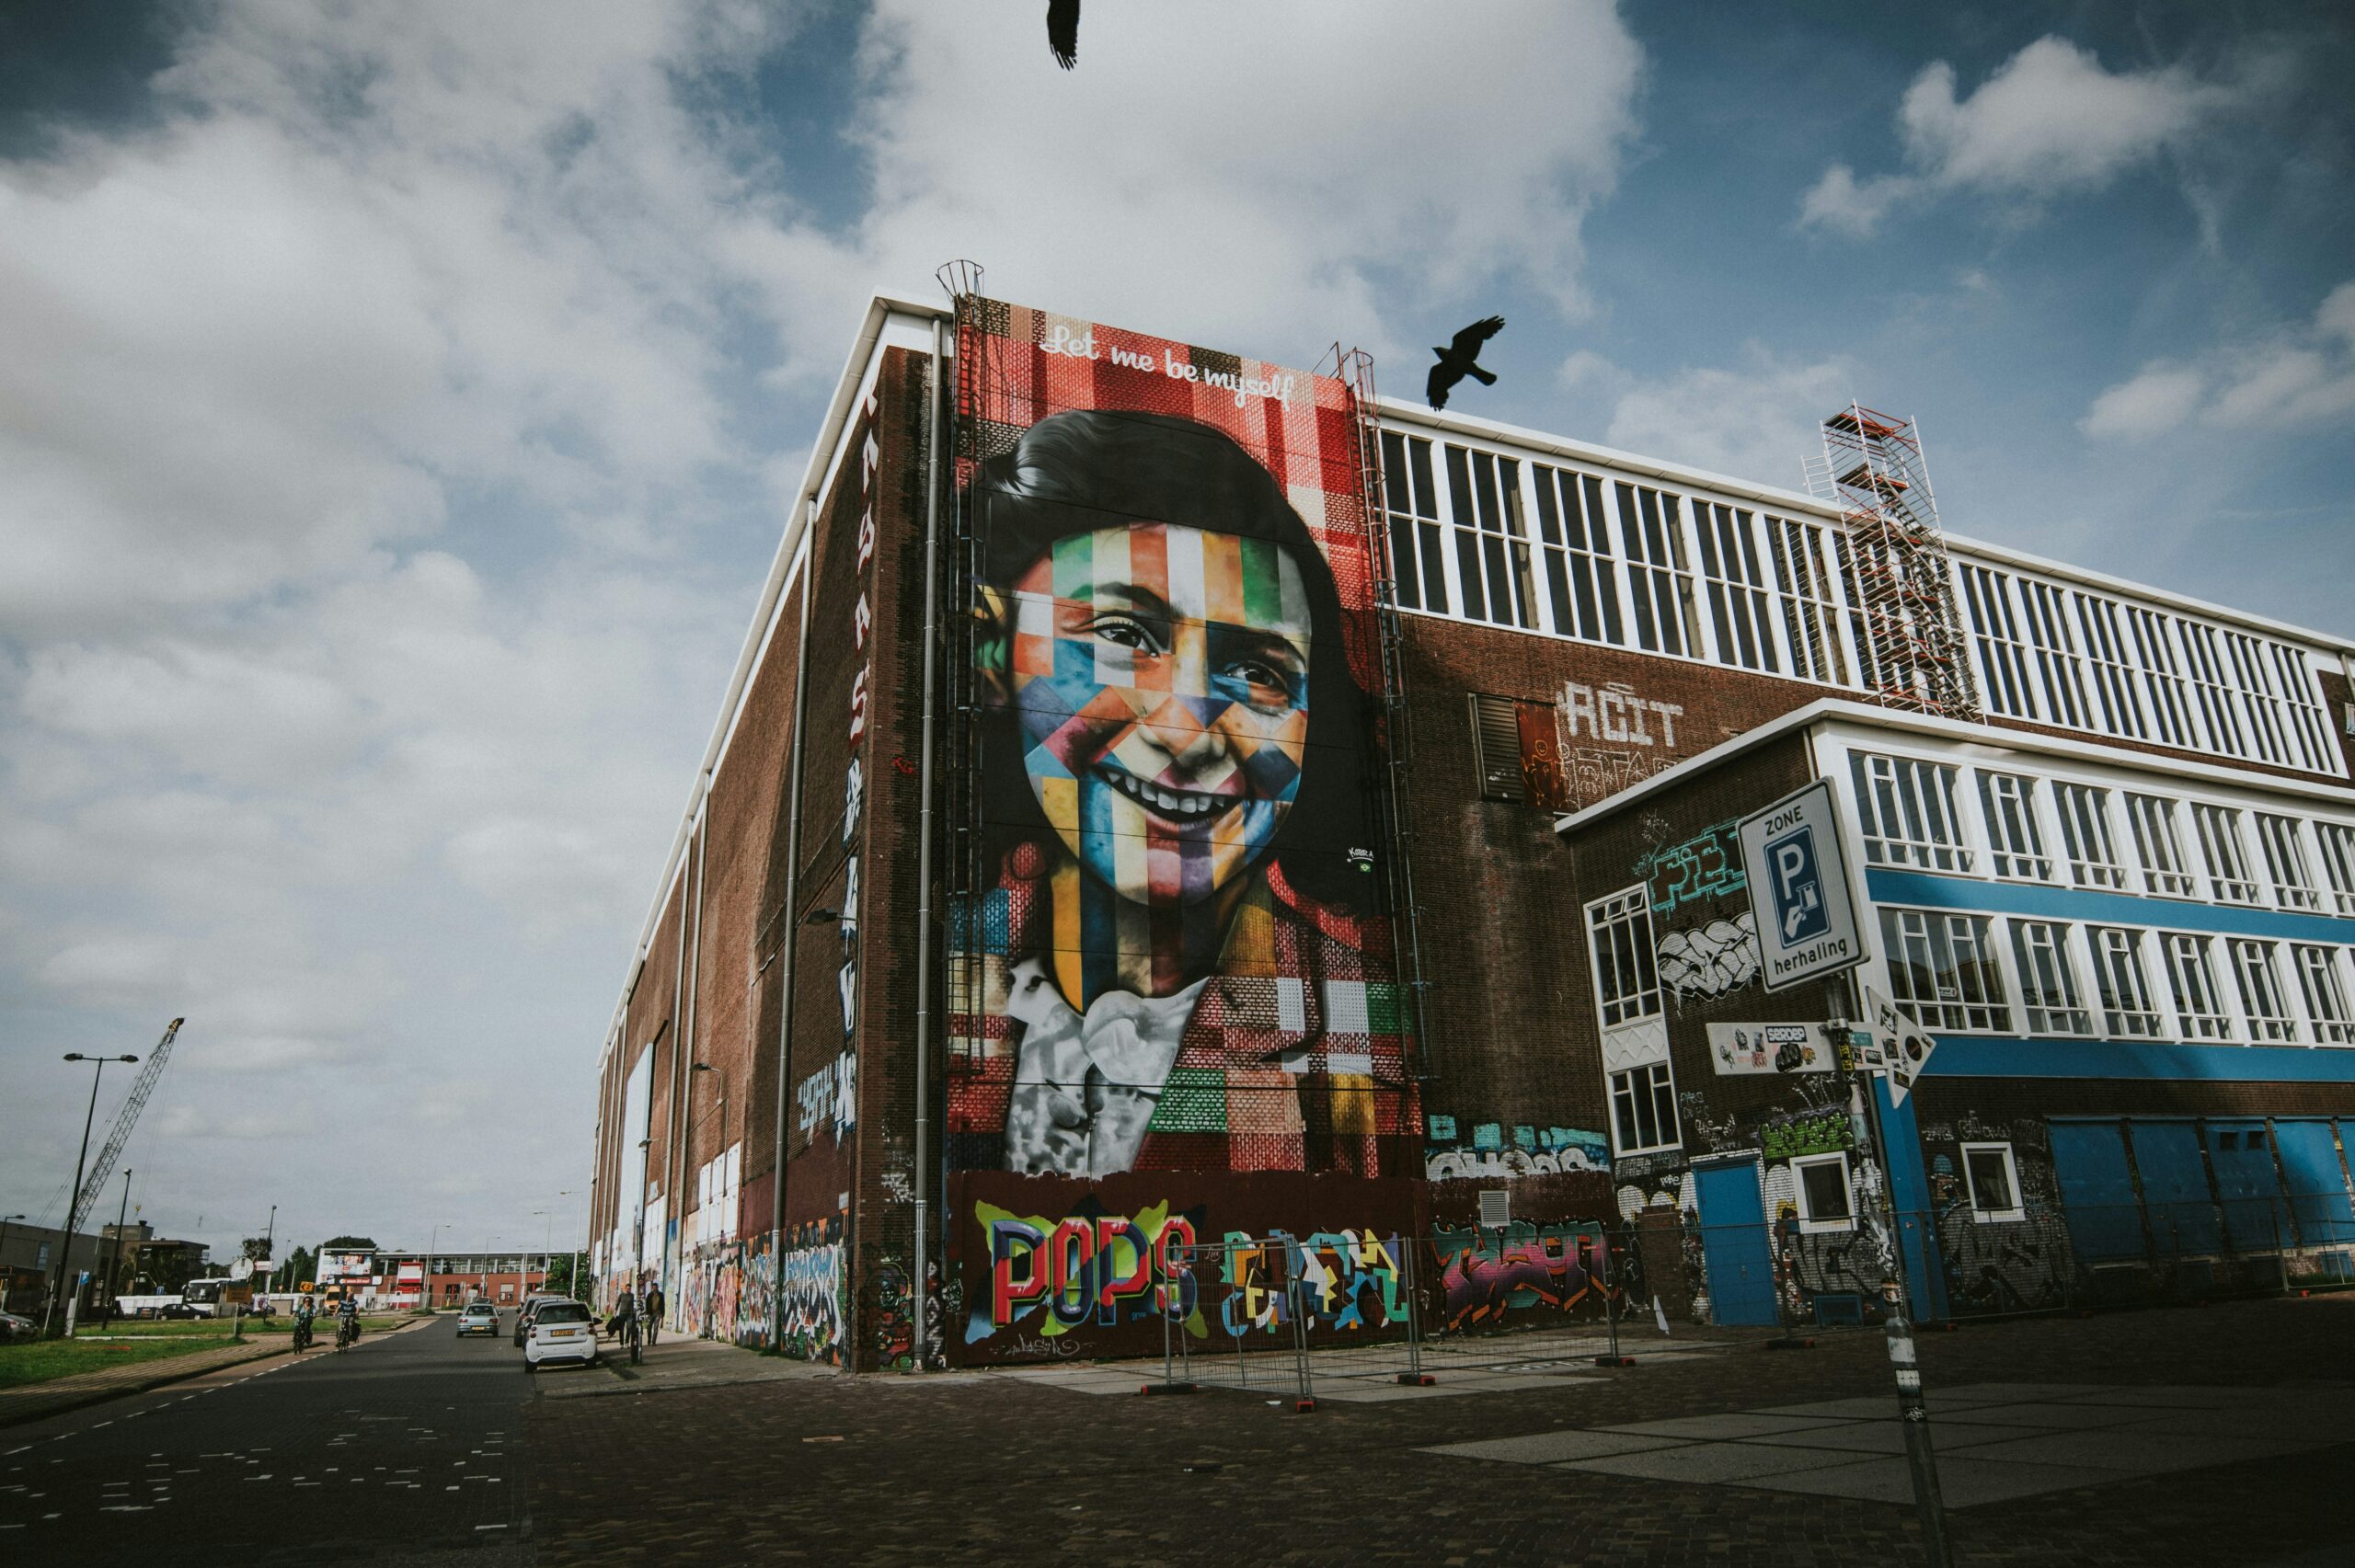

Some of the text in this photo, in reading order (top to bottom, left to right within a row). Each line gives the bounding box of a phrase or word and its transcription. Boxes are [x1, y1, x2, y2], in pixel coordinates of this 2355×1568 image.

[1040, 326, 1293, 410] Let me be myself
[1765, 806, 1804, 836] ZONE
[1776, 843, 1805, 900] P
[1775, 937, 1848, 975] herhaling
[992, 1215, 1198, 1328] POPS
